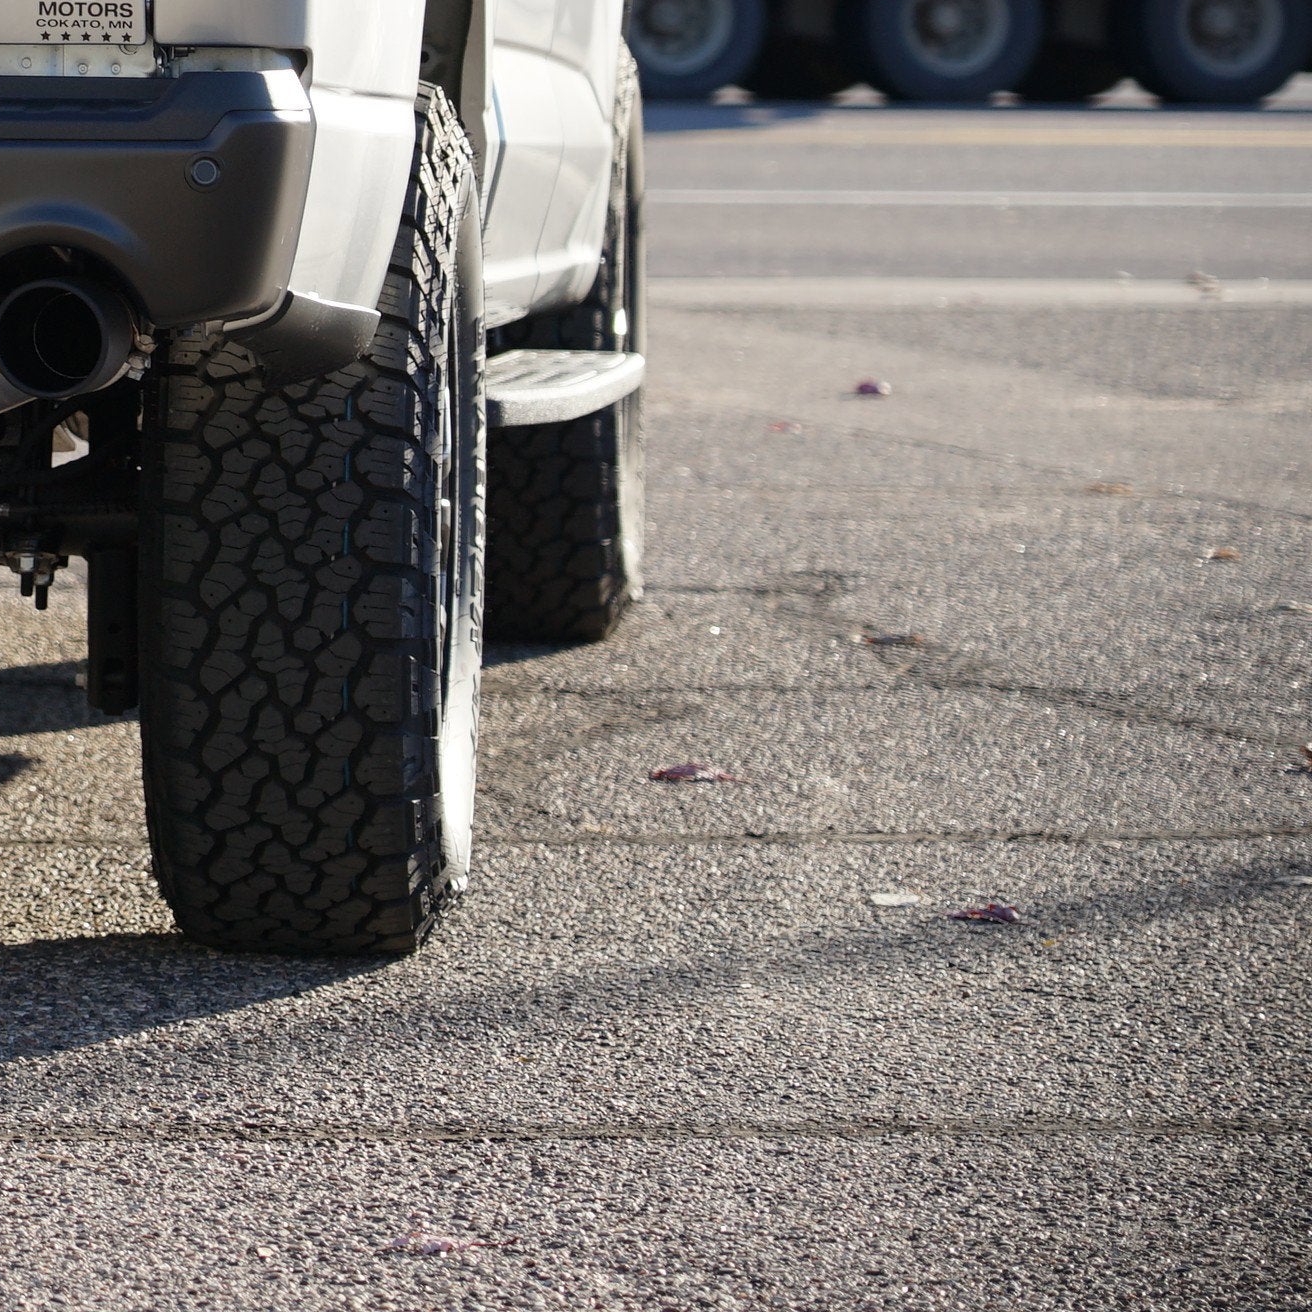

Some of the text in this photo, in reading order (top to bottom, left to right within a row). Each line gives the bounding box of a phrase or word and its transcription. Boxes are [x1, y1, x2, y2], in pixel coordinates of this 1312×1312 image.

[38, 1, 134, 18] MOTORS
[36, 19, 133, 30] COKATO, MN
